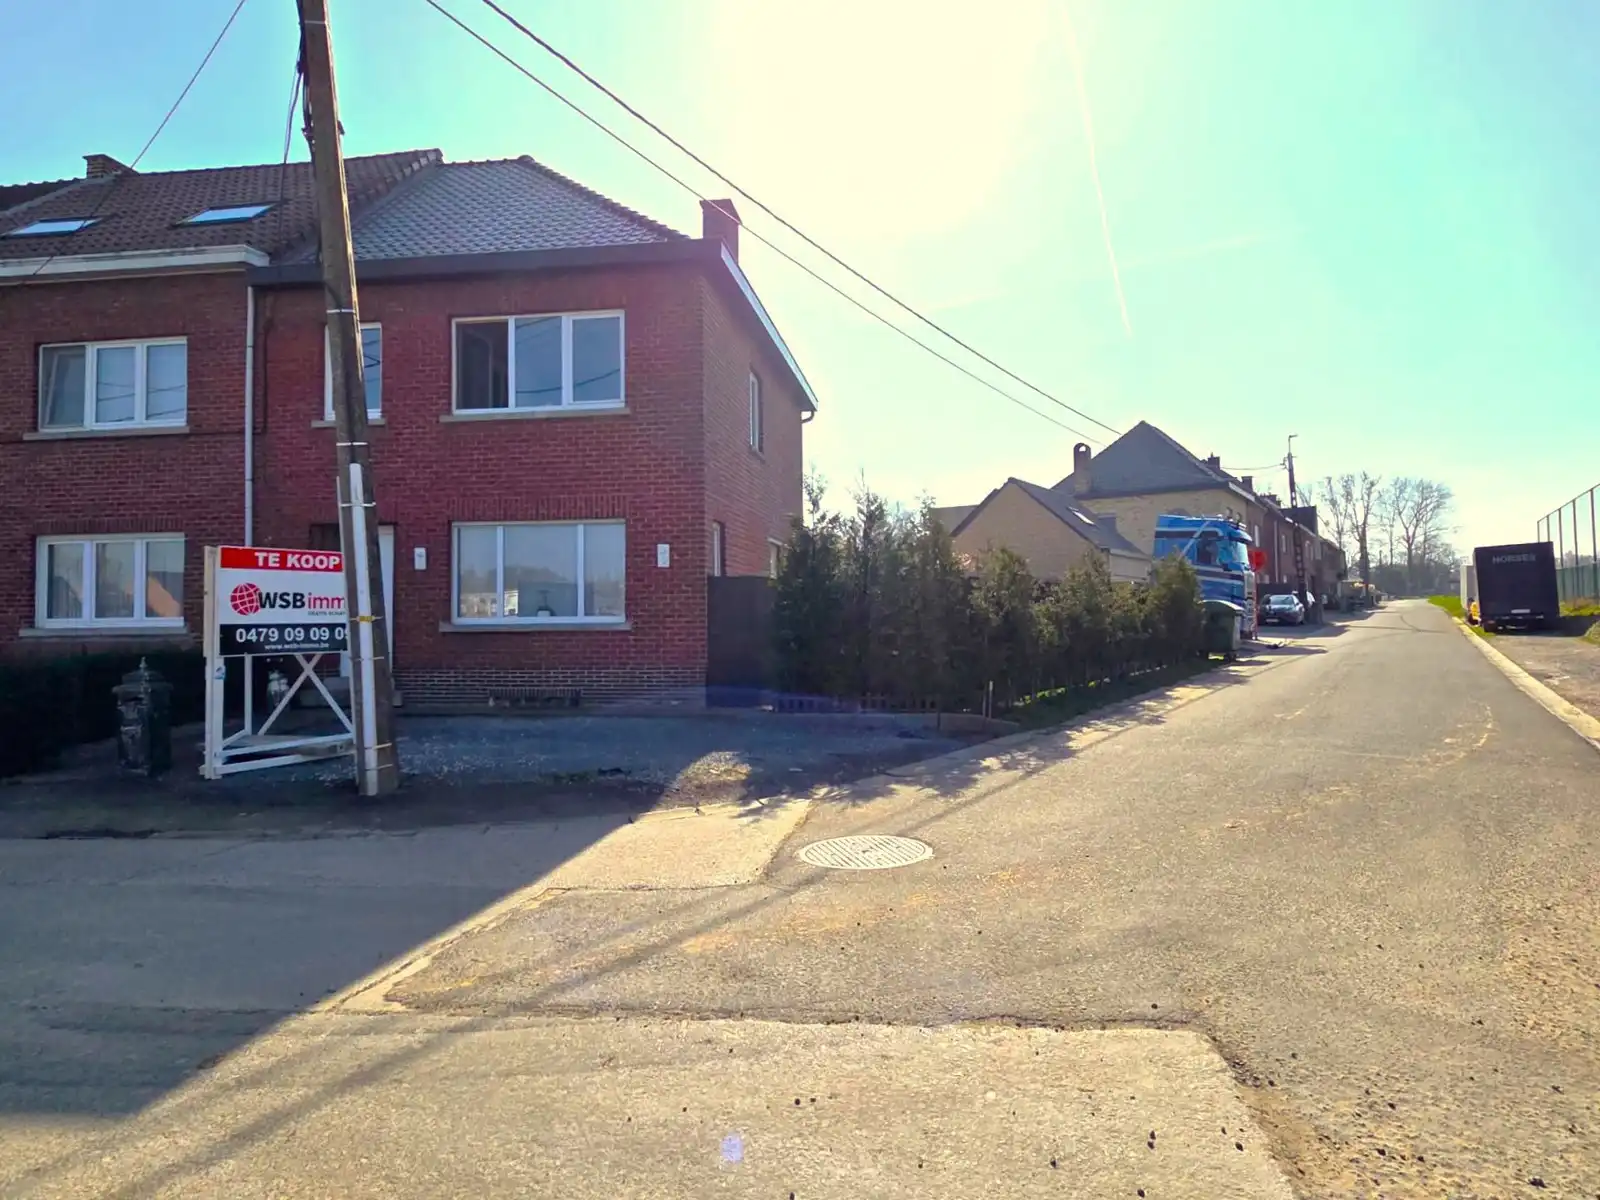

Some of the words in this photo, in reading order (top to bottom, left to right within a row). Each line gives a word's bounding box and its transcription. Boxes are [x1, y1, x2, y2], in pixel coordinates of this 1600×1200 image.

[254, 552, 280, 567] TE
[286, 554, 340, 569] KOOP
[235, 628, 279, 642] 0479
[284, 627, 305, 641] 09
[310, 627, 330, 641] 09
